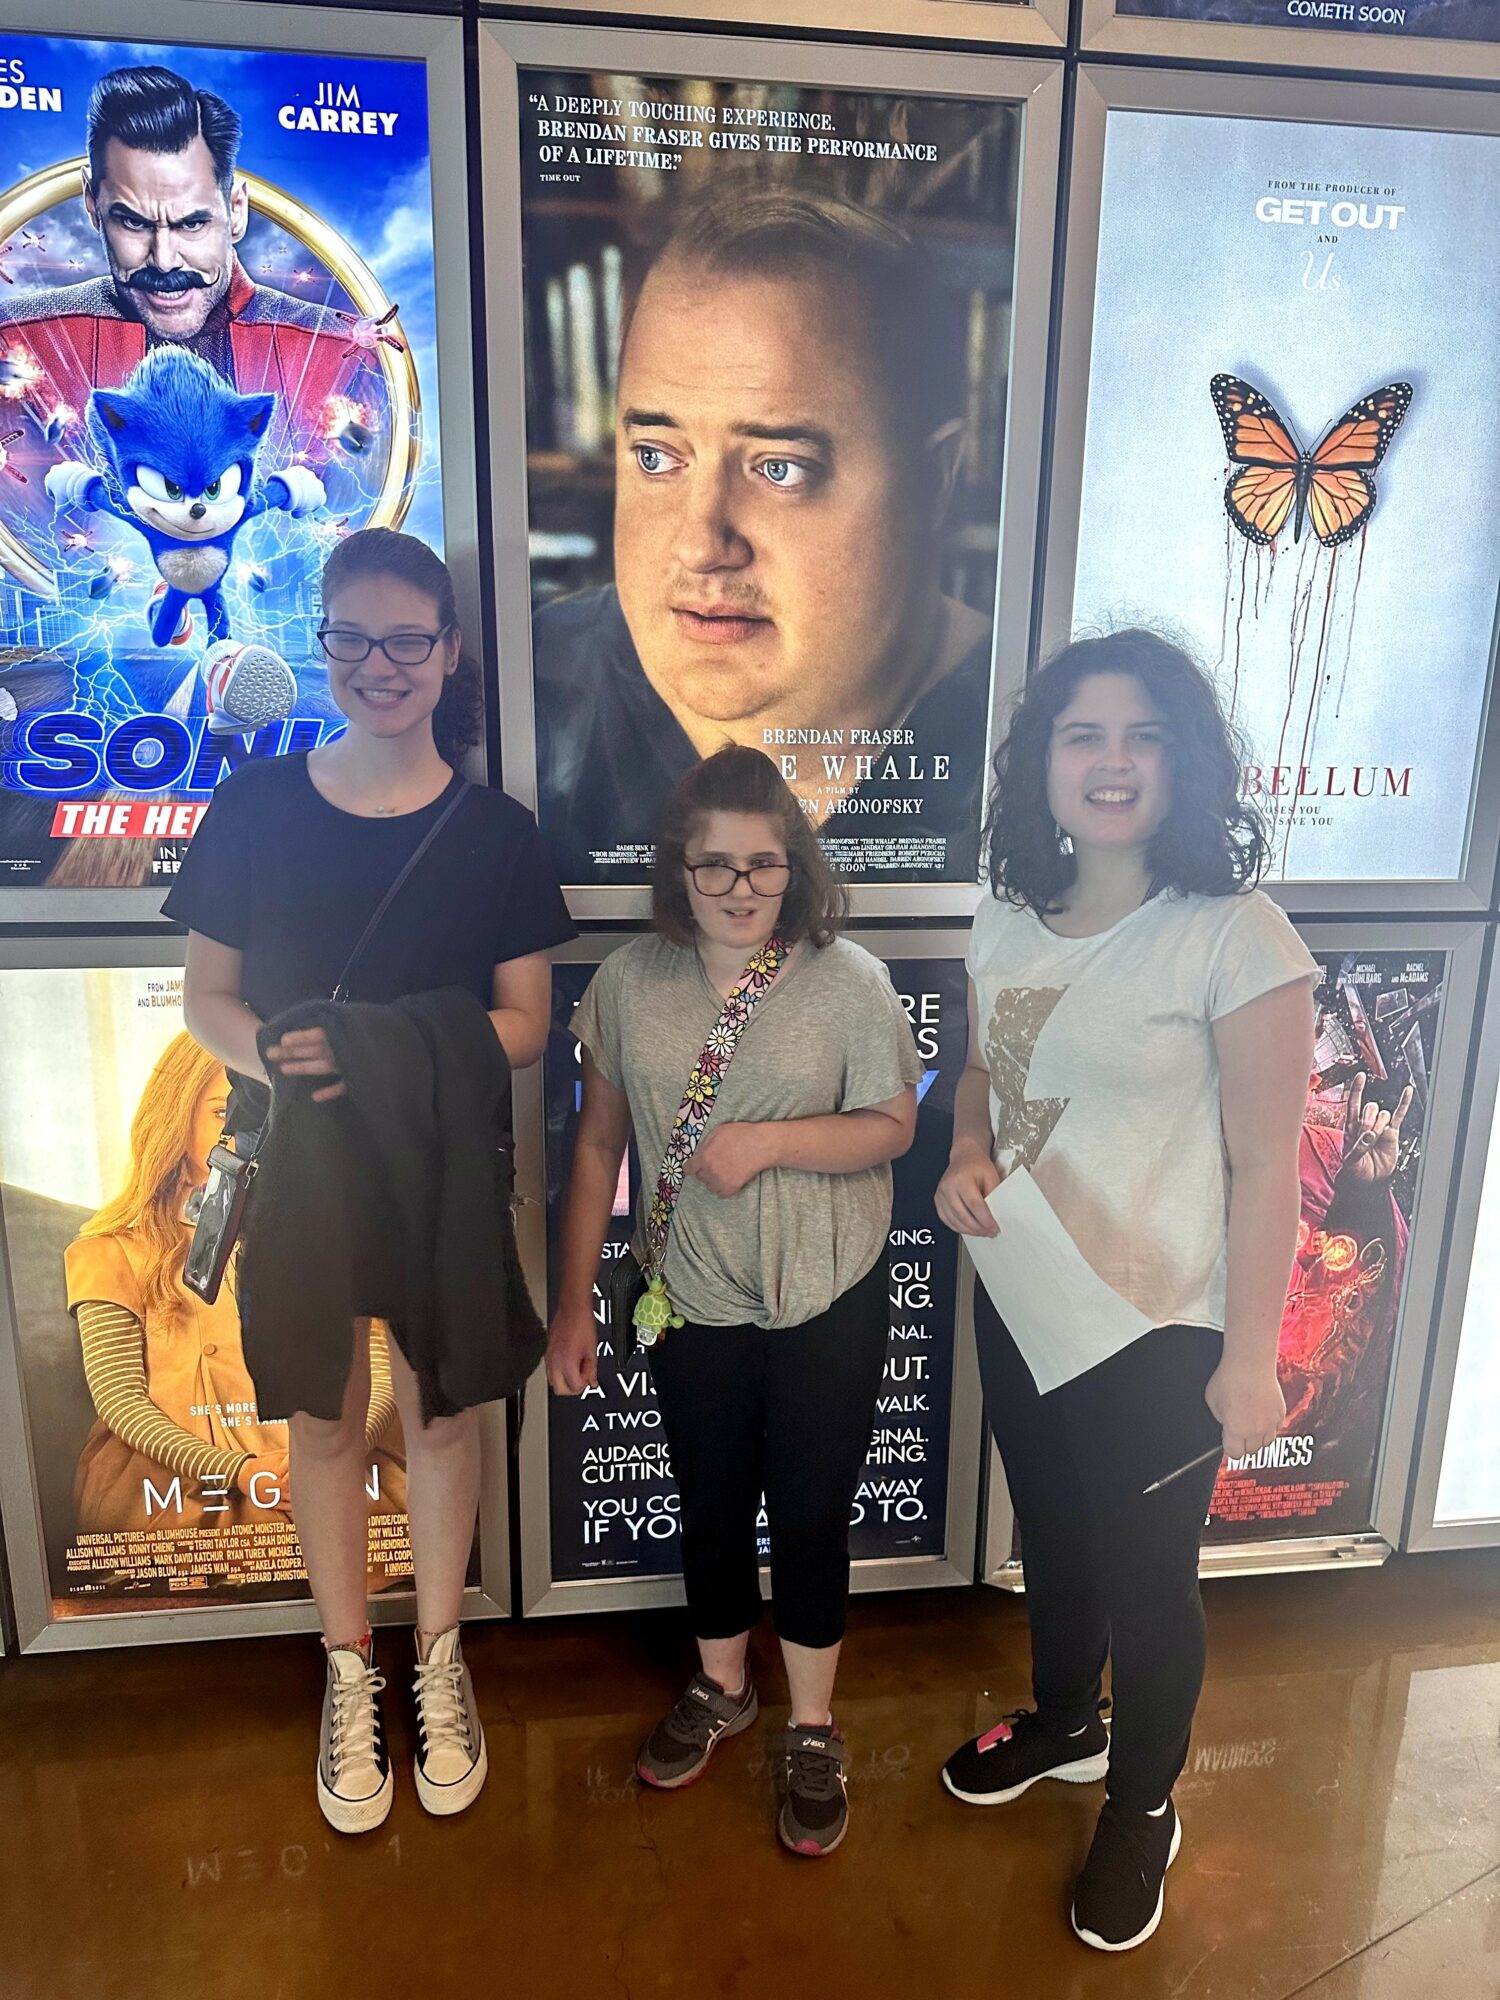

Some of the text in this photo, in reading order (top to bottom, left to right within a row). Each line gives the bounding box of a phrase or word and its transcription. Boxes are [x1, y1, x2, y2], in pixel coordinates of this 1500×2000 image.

[1287, 0, 1407, 26] COMETH SOON
[0, 58, 26, 84] ES
[0, 84, 62, 113] DEN
[313, 81, 361, 109] JIM
[278, 105, 400, 137] CARREY
[554, 95, 623, 117] DEEPLY
[628, 100, 717, 125] TOUCHING
[722, 107, 837, 132] EXPERIENCE.
[537, 119, 938, 162] BRENDAN FRASER GIVES THE PERFORMANCE
[539, 145, 564, 163] OF
[567, 146, 581, 164] A
[539, 173, 581, 183] TIME OUT
[1268, 180, 1397, 196] FROM THE PRODUCER OF
[1255, 196, 1406, 231] GET OUT
[1316, 235, 1339, 244] AND
[1301, 250, 1342, 291] Us
[762, 728, 915, 745] BRENDAN FRASER
[780, 754, 950, 781] E WHALE
[1240, 765, 1414, 797] BELLUM
[817, 786, 860, 795] A FILM BY
[800, 798, 924, 815] EN ARONOFSKY
[1299, 806, 1322, 815] YOU
[61, 804, 133, 835] THE
[1278, 817, 1307, 827] SAVE
[1311, 817, 1335, 827] YOU
[159, 846, 177, 860] IN
[152, 860, 182, 874] FEB
[839, 863, 867, 872] SOON
[1355, 962, 1425, 973] MICHAEL RACHEL
[1400, 972, 1429, 984] McADAMS
[147, 982, 165, 993] FROM
[138, 998, 150, 1008] AND
[901, 993, 941, 1025] RE
[600, 1228, 936, 1260] STA KING.
[890, 1261, 931, 1283] OU
[889, 1283, 934, 1310] NG.
[890, 1324, 933, 1341] NAL.
[885, 1355, 931, 1381] UT.
[189, 1402, 256, 1416] SHE'S MORE
[220, 1415, 252, 1428] SHE'S
[581, 1413, 600, 1433] A
[604, 1410, 662, 1431] TWO
[870, 1427, 929, 1446] GINAL.
[865, 1444, 927, 1466] HING.
[582, 1497, 638, 1519] YOU
[854, 1477, 923, 1500] AWAY
[584, 1518, 610, 1545] IF
[623, 1513, 683, 1542] YO
[877, 1497, 928, 1524] TO.
[76, 1522, 297, 1546] UNIVERSAL PICTURES AND BLUMHOUSE PRESENT AN ATOMIC MONSTER PRO
[381, 1526, 404, 1538] WILLIS
[66, 1541, 176, 1559] ALLISON WILLIAMS RONNY CHIENG
[194, 1535, 276, 1551] TERRI TAYLOR CSA SARAH
[380, 1538, 411, 1550] HENDRICK
[92, 1545, 296, 1570] ALLISON WILLIAMS MARK DAVID KATCHUR RYAN TUREK MICHAEL
[255, 1557, 302, 1571] AKELA COOPER
[372, 1550, 394, 1563] AKELA
[136, 1562, 230, 1579] JASON BLUM JAMES WAN
[389, 1561, 415, 1574] UNIVERSA
[246, 1571, 272, 1584] GERARD
